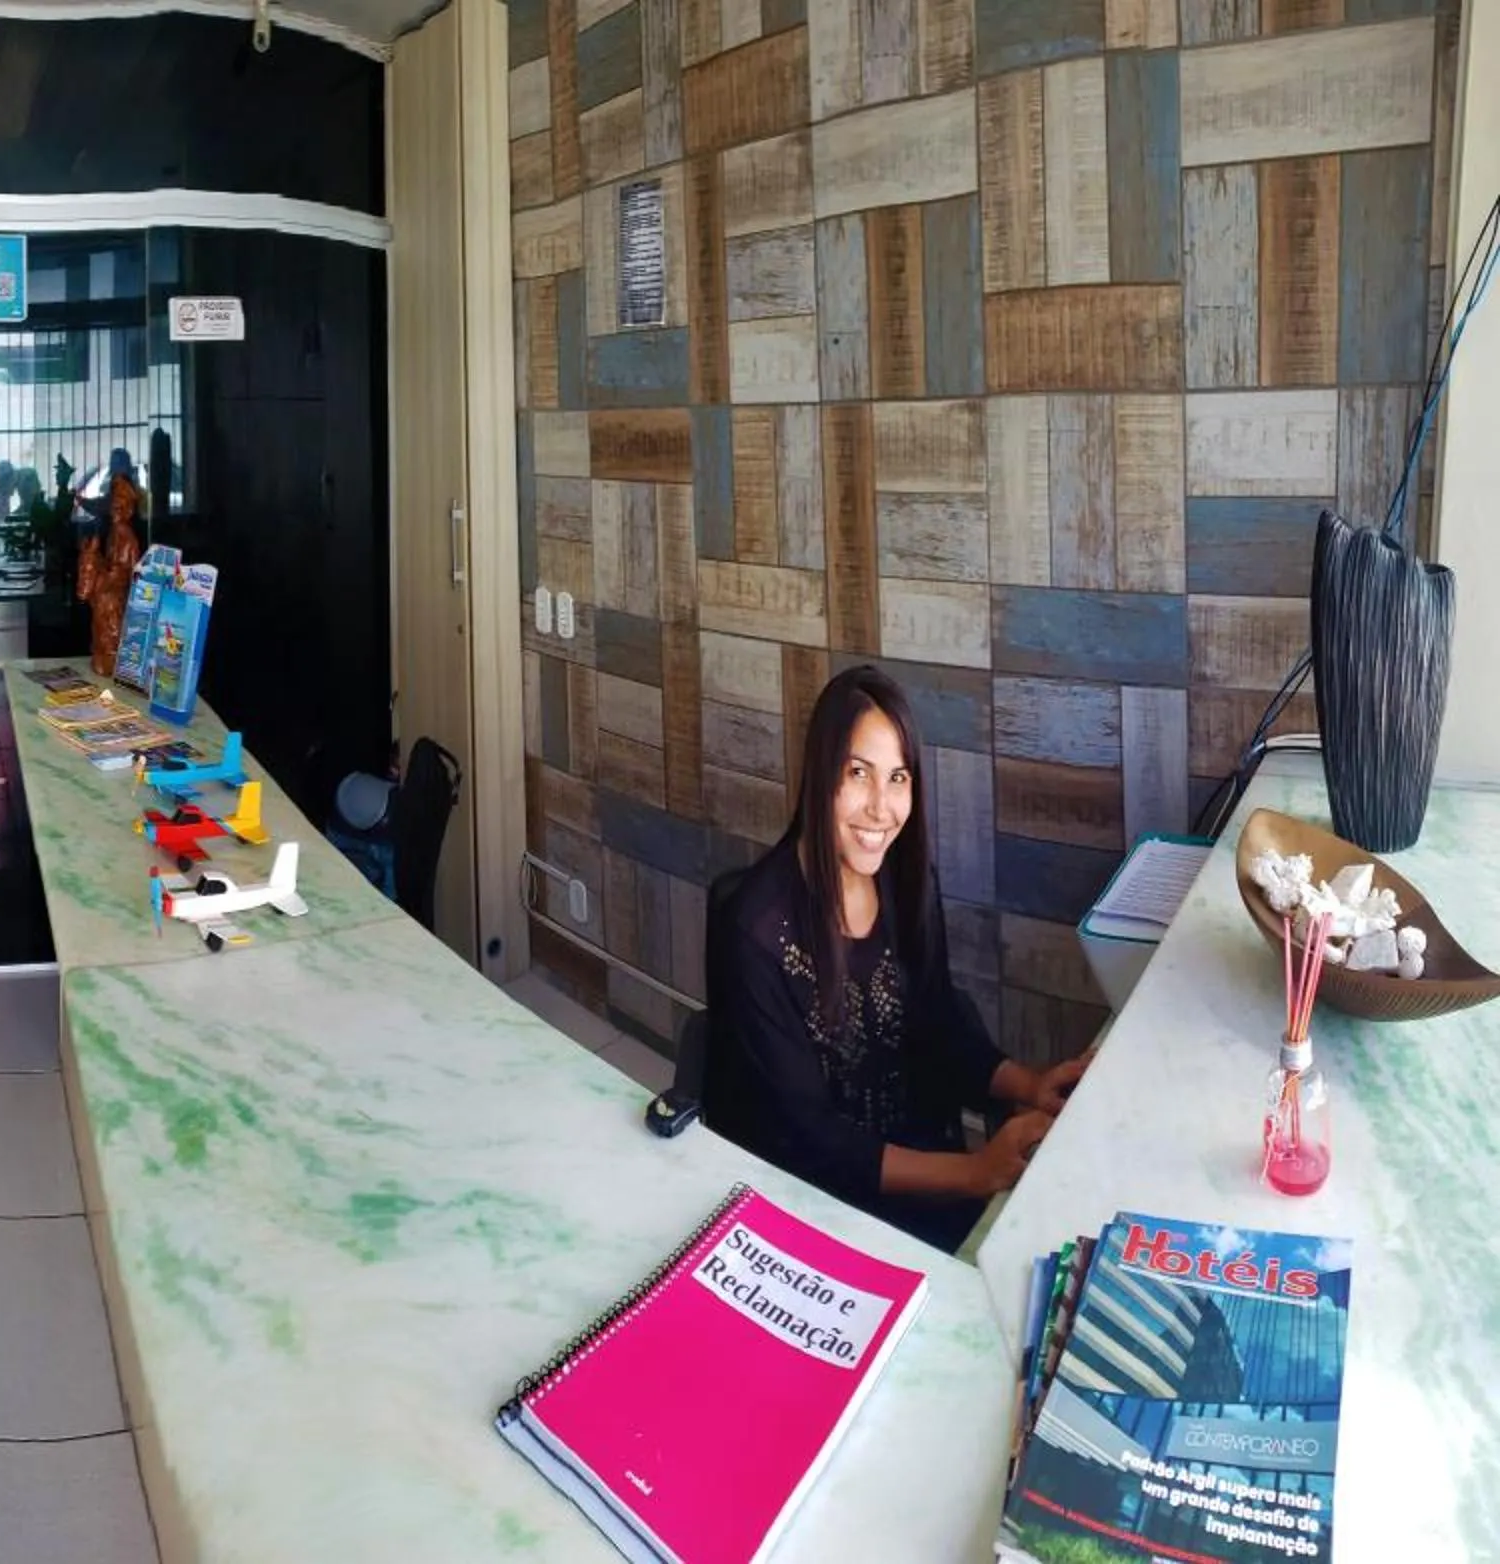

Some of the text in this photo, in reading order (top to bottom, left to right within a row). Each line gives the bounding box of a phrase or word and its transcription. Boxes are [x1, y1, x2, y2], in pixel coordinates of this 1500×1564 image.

[725, 1228, 856, 1316] Sugestão e
[1122, 1224, 1319, 1297] Hotéis
[700, 1255, 857, 1361] Reclamação.
[1120, 1451, 1176, 1479] Padrão
[1218, 1478, 1276, 1504] supera
[1277, 1490, 1322, 1511] mais
[1141, 1478, 1319, 1533] um grande desafio de
[1205, 1515, 1319, 1557] implantação
